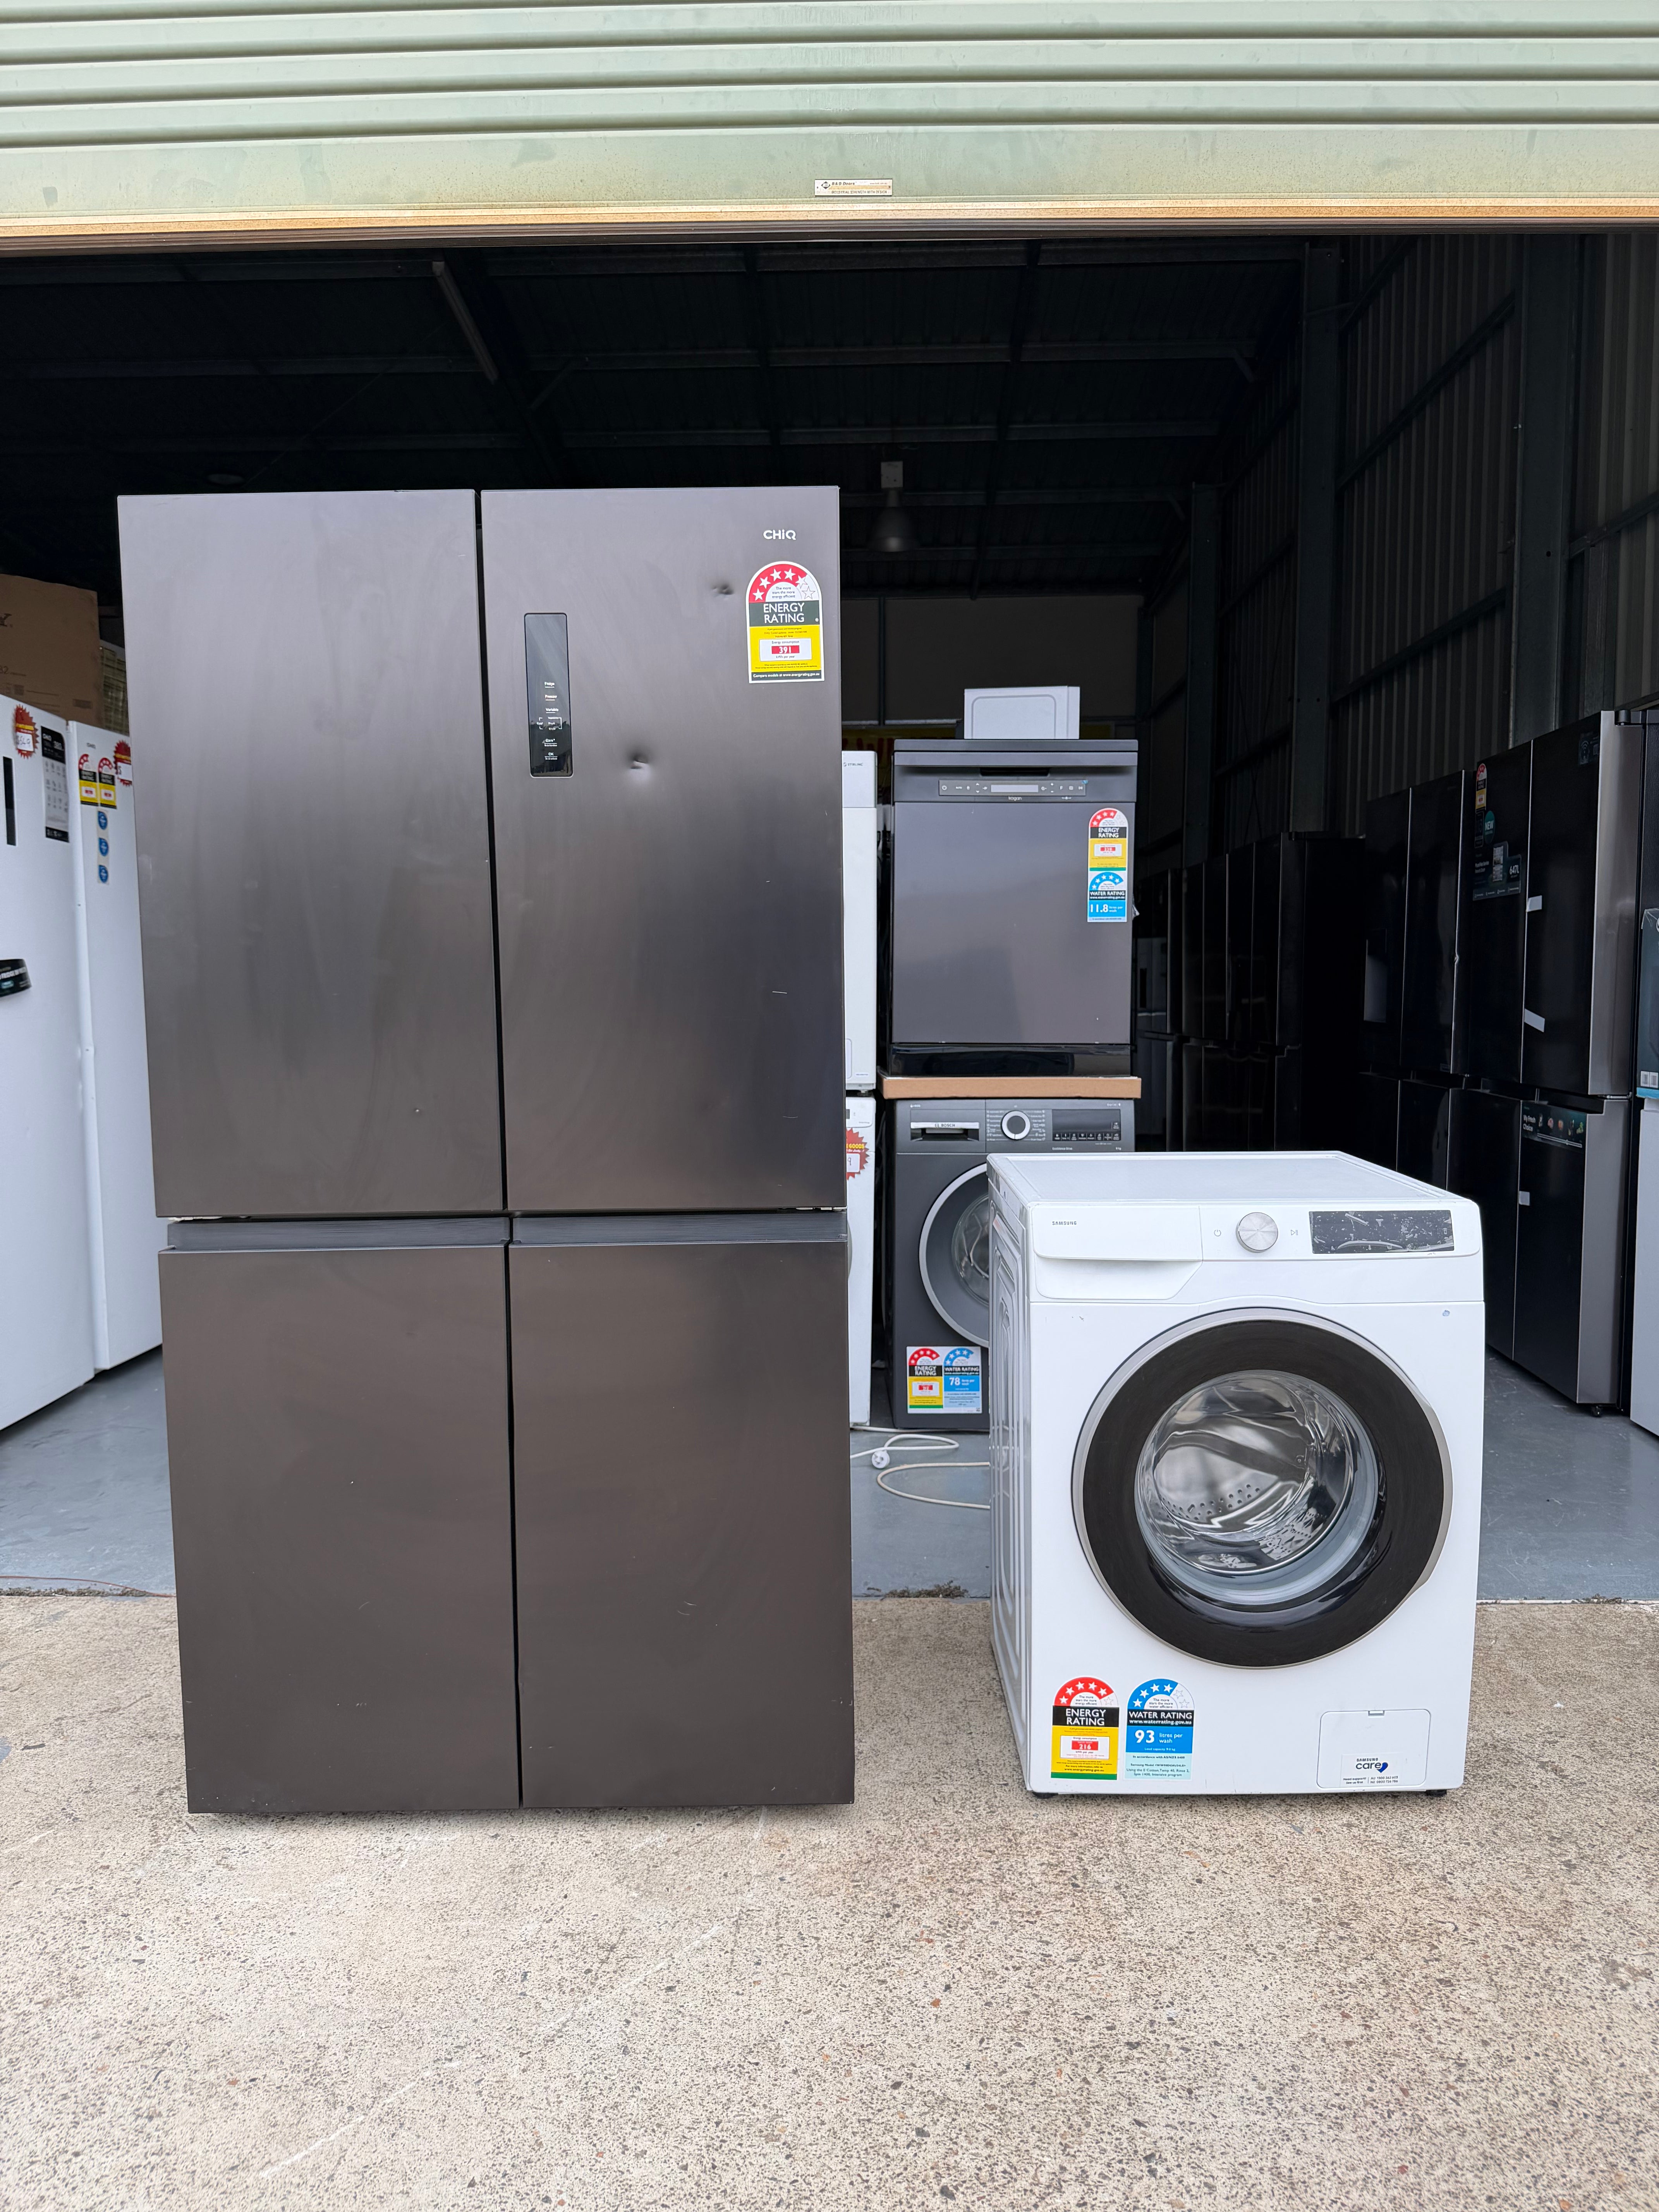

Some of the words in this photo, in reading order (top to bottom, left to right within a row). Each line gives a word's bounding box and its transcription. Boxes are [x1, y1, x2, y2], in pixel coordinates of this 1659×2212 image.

[763, 602, 805, 613] ENERGY
[764, 613, 804, 623] RATING
[1485, 820, 1494, 831] NEW
[1510, 865, 1519, 875] 647L
[1090, 904, 1109, 912] 11.8
[949, 1377, 960, 1386] 78
[1066, 1708, 1106, 1717] ENERGY
[1066, 1717, 1104, 1726] RATING
[1135, 1729, 1154, 1743] 93
